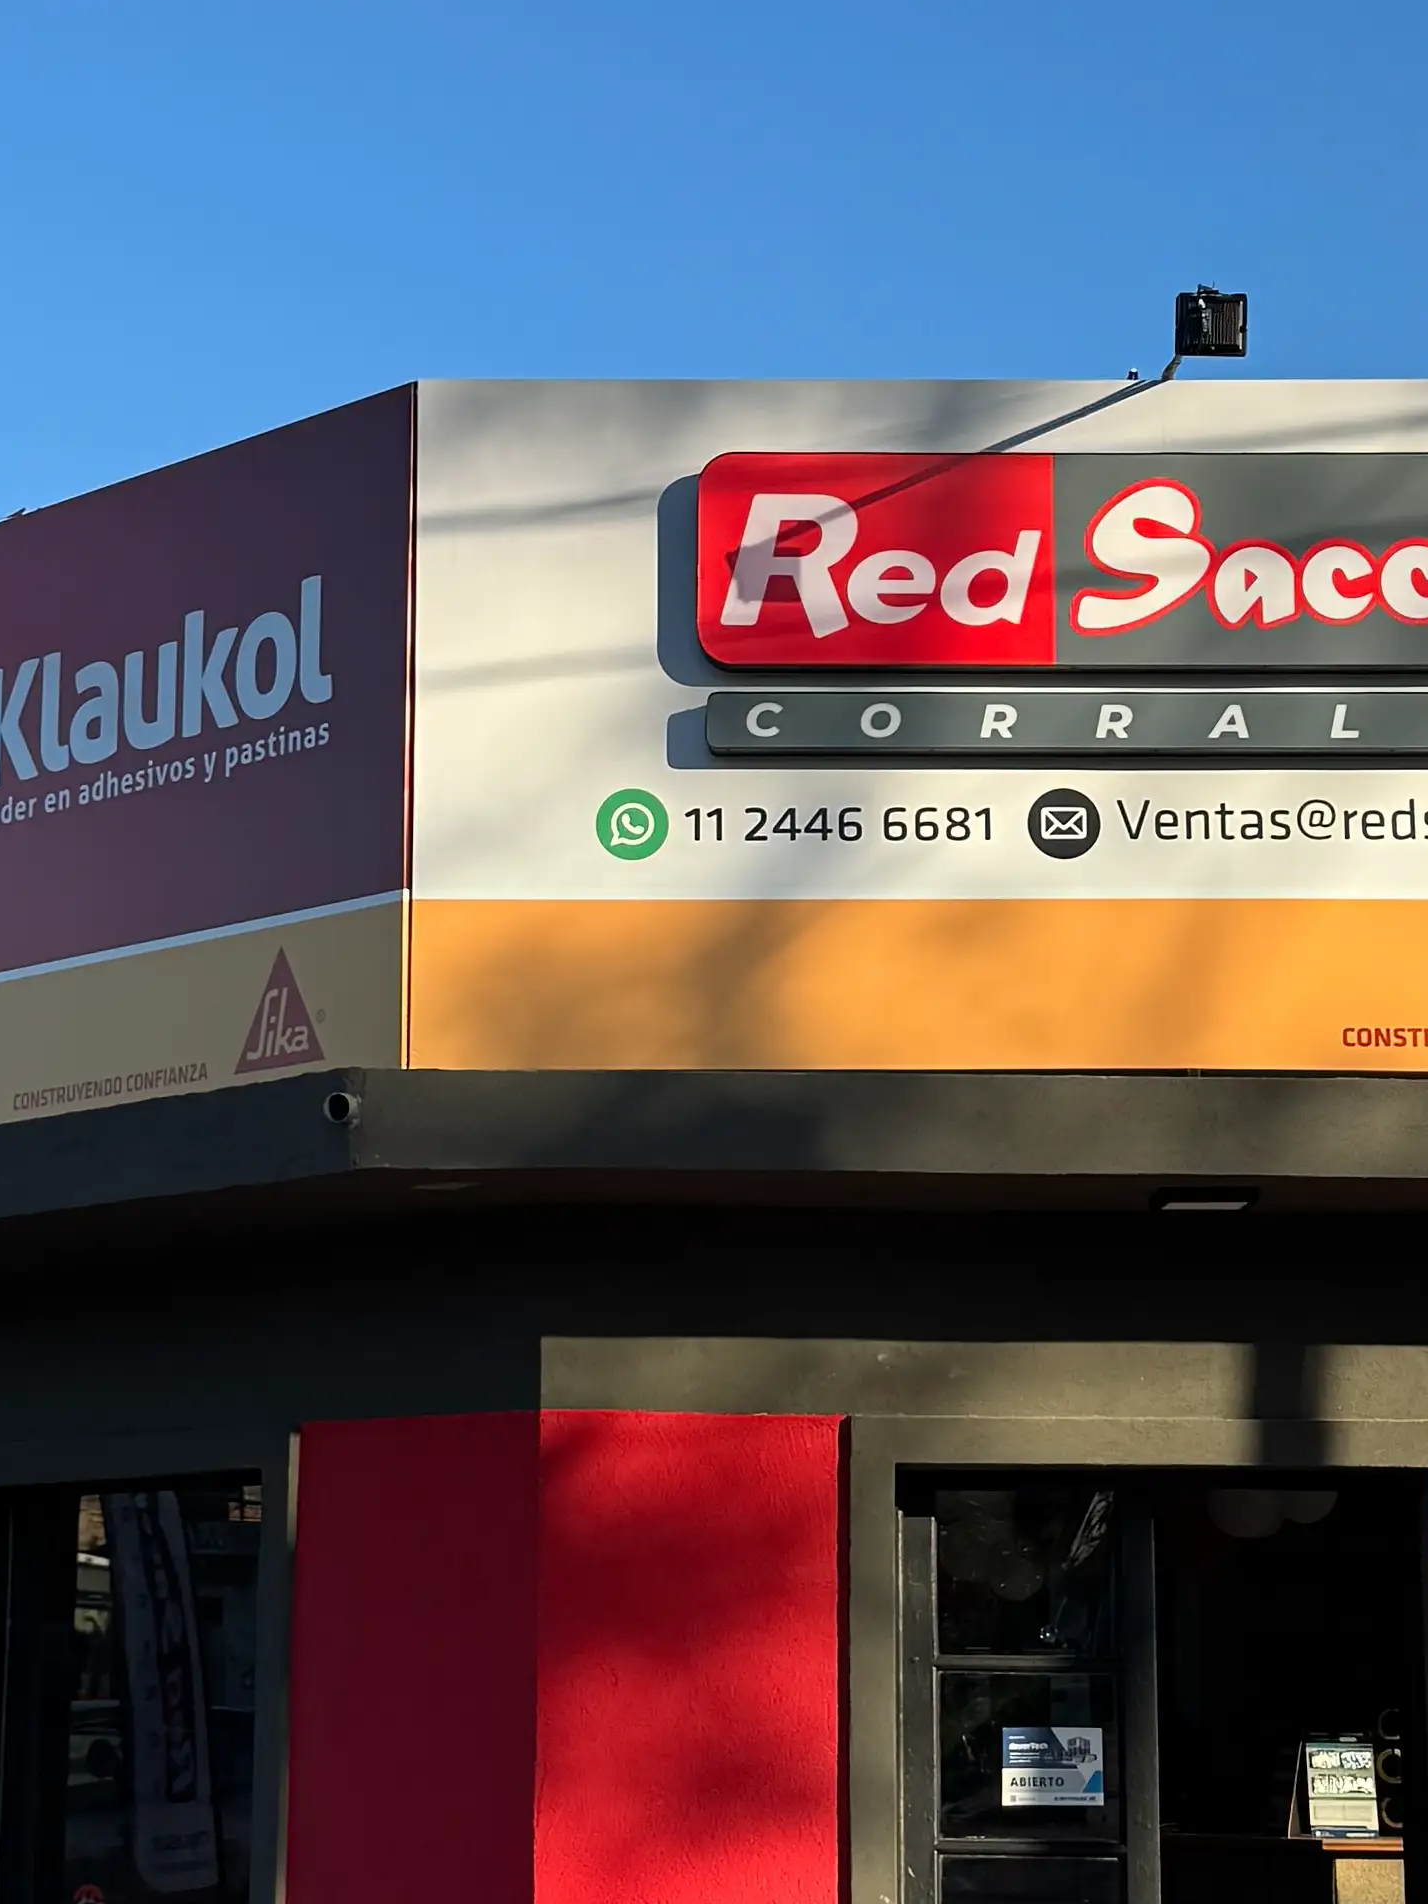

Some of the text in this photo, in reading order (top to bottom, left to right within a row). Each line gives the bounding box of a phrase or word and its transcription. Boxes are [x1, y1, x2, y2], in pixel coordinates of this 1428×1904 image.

[721, 493, 1044, 639] Red
[44, 788, 70, 814] en
[78, 753, 195, 806] adhesivos
[203, 749, 218, 782] y
[224, 723, 329, 778] pastinas
[683, 808, 726, 843] 11
[743, 807, 864, 843] 2446
[881, 807, 994, 843] 6681
[246, 986, 310, 1062] Sika
[12, 1063, 208, 1111] CONSTRUYENDO CONFIANZA
[1010, 1776, 1065, 1787] ABIERTO
